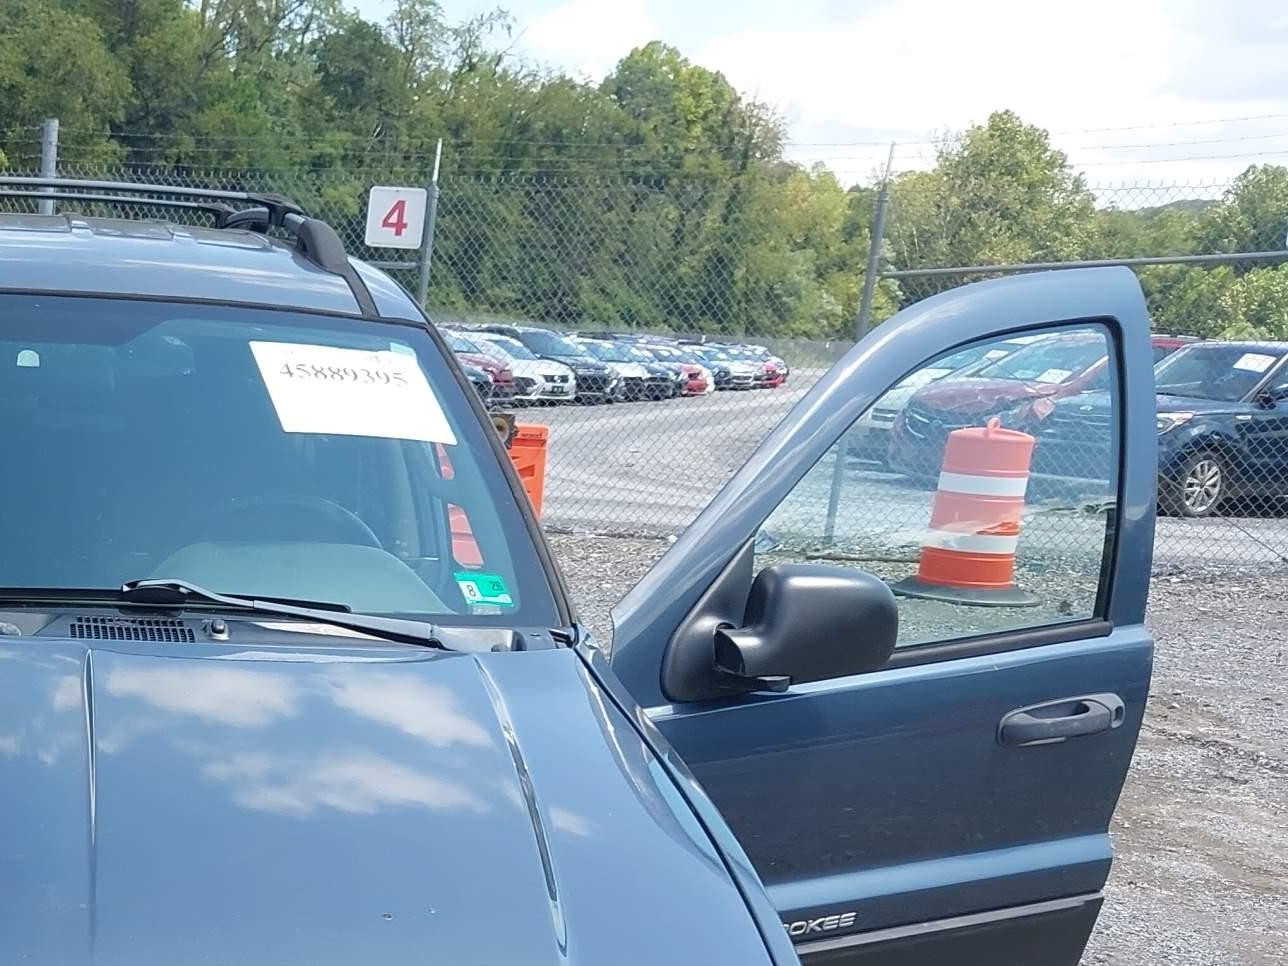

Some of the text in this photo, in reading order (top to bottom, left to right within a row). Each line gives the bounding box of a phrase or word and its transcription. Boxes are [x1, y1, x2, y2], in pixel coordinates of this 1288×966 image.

[382, 200, 408, 237] 4
[279, 362, 409, 387] 45889395
[466, 584, 476, 598] 8
